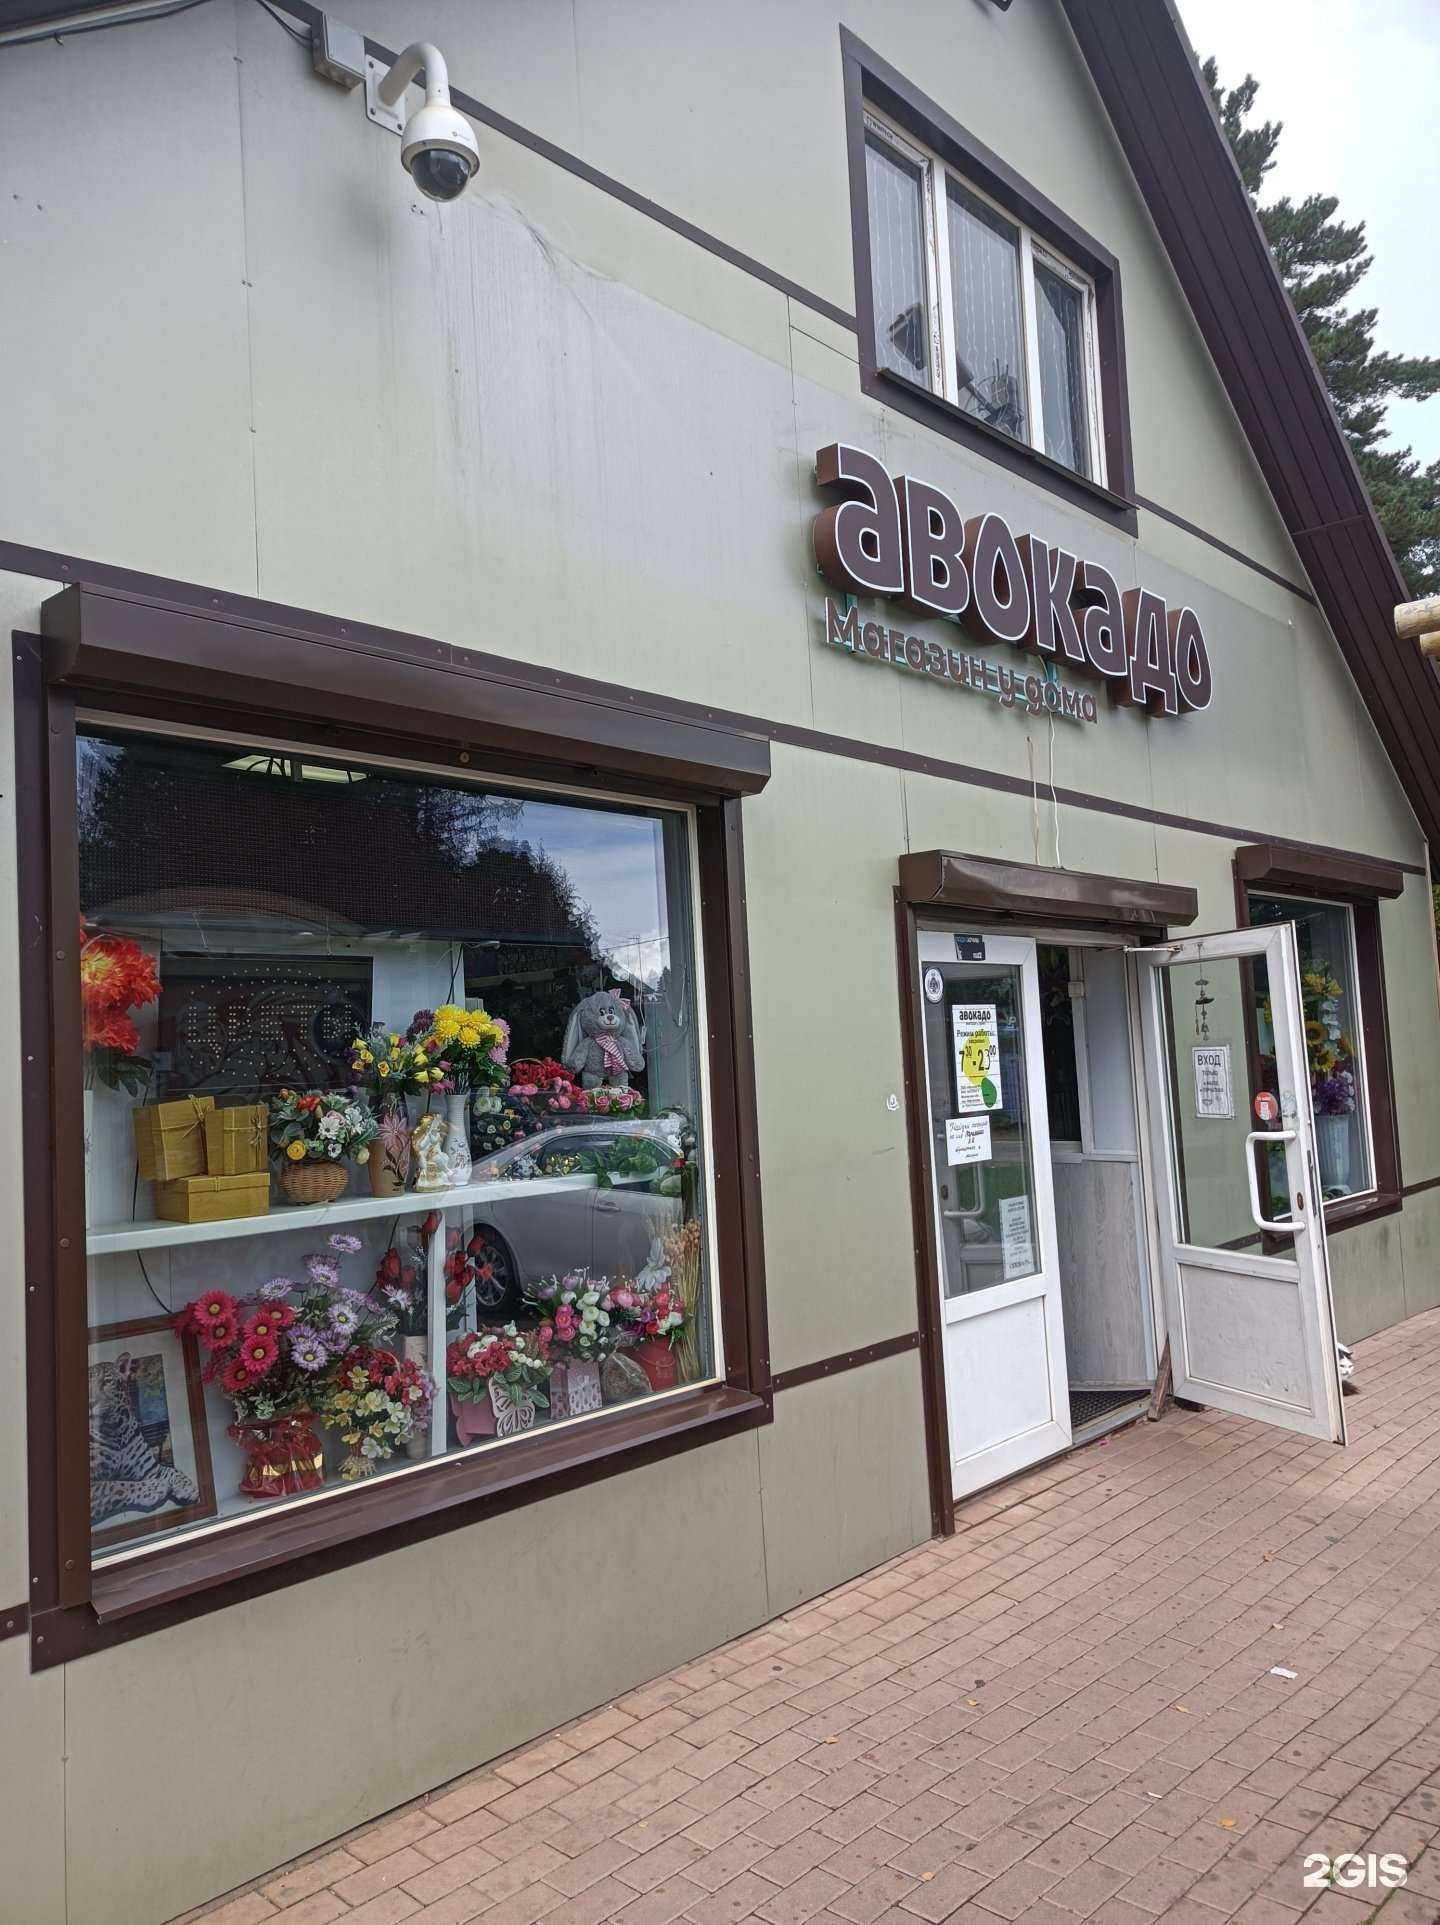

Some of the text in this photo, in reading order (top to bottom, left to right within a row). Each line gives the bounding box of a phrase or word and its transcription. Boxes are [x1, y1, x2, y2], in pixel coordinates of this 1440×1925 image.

[814, 442, 1213, 716] авокадо
[824, 596, 1098, 724] Магазин у дома
[187, 1004, 352, 1059] ЦВЕТЫ
[959, 1010, 991, 1021] авокадо
[1197, 1054, 1221, 1067] ВХОД
